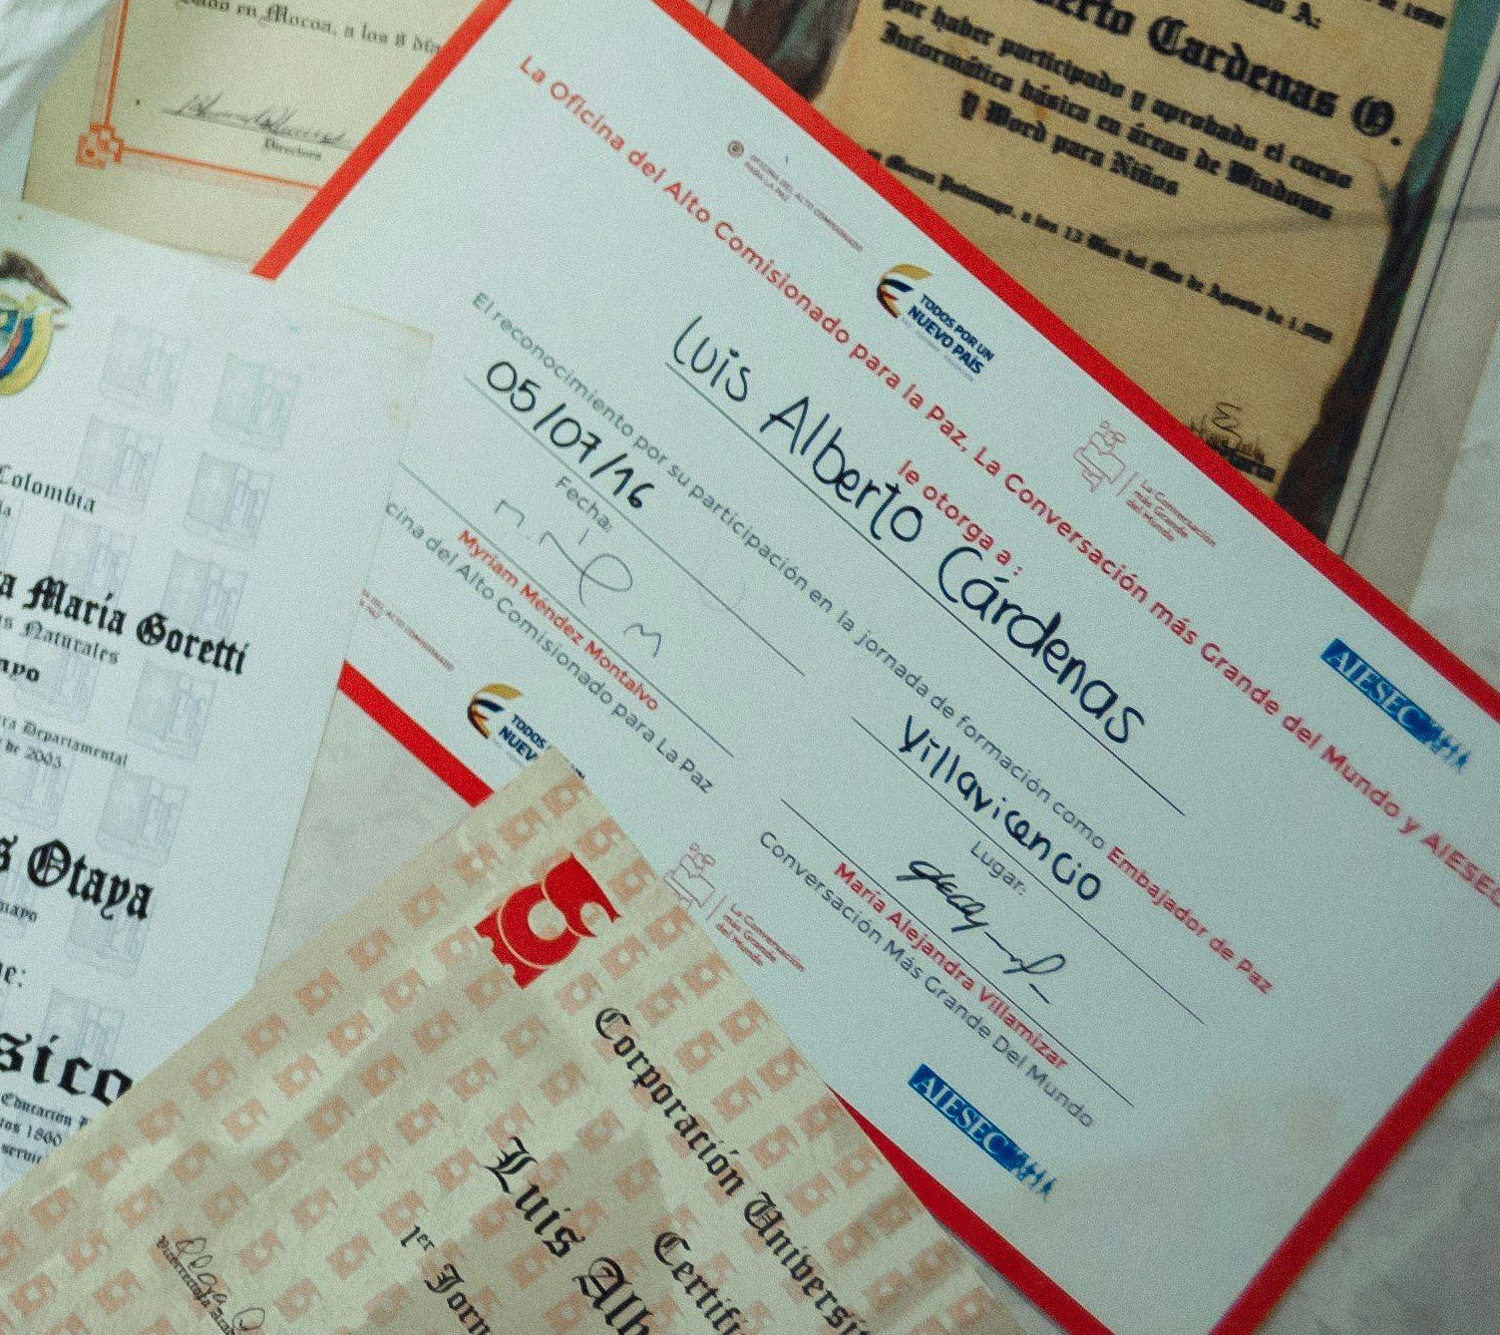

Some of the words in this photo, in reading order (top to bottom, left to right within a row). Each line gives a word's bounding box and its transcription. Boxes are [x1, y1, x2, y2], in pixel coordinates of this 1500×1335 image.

[1147, 15, 1340, 121] Cardenas
[1352, 93, 1404, 147] O.
[517, 53, 546, 82] La
[546, 72, 626, 147] Oficina
[623, 147, 666, 185] del
[661, 172, 712, 227] Alto
[712, 219, 853, 346] Comisionado
[483, 358, 656, 513] 05/07/16
[664, 313, 752, 407] Luis
[759, 382, 928, 546] Alberto
[933, 550, 1148, 752] Cárdenas
[23, 575, 125, 641] María
[135, 610, 250, 676] Goretti
[1327, 650, 1425, 739] AIESEC
[26, 836, 155, 922] Otaya
[895, 712, 1103, 902] Villavicencio
[832, 860, 887, 910] María
[886, 910, 977, 994] Alejandra
[977, 984, 1070, 1071] Villamizar
[592, 1005, 745, 1198] Corporación
